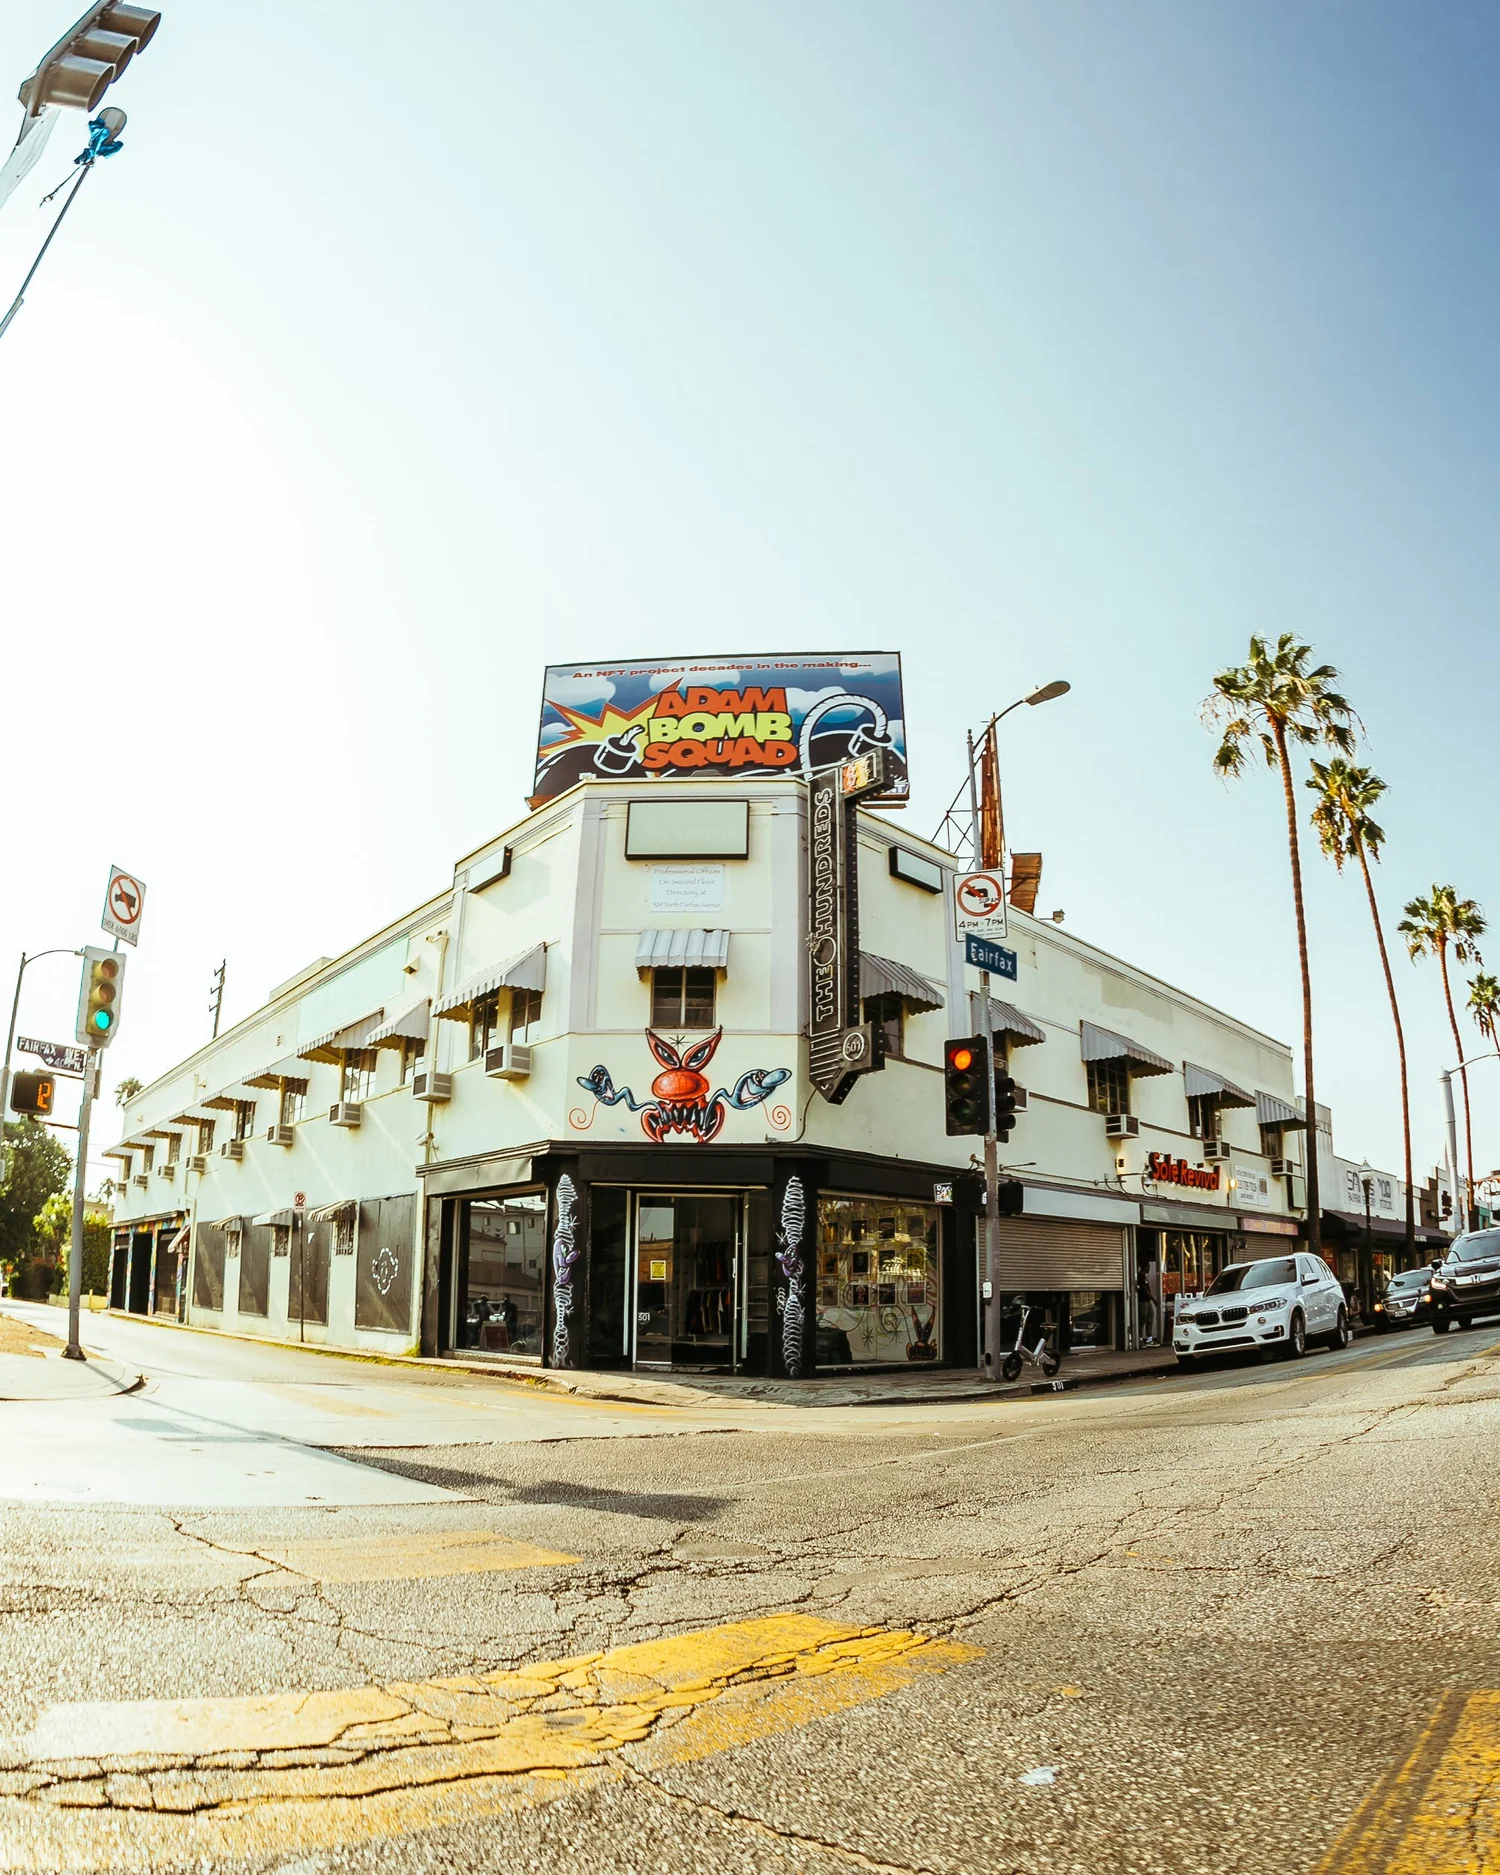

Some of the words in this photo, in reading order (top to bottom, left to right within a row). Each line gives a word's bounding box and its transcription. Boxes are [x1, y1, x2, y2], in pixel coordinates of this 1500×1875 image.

[572, 671, 593, 679] An
[596, 669, 627, 677] NFT
[629, 667, 686, 676] project
[689, 664, 754, 672] decades
[652, 686, 789, 718] ADAM
[648, 712, 793, 743] BOMB
[641, 736, 798, 769] SQUAD
[813, 787, 834, 938] HUNDREDS
[970, 942, 1013, 972] Fairfax
[815, 964, 834, 1023] THE
[18, 1038, 57, 1056] FAIRFAX
[1149, 1152, 1179, 1183] Sole
[1177, 1159, 1221, 1190] Revival
